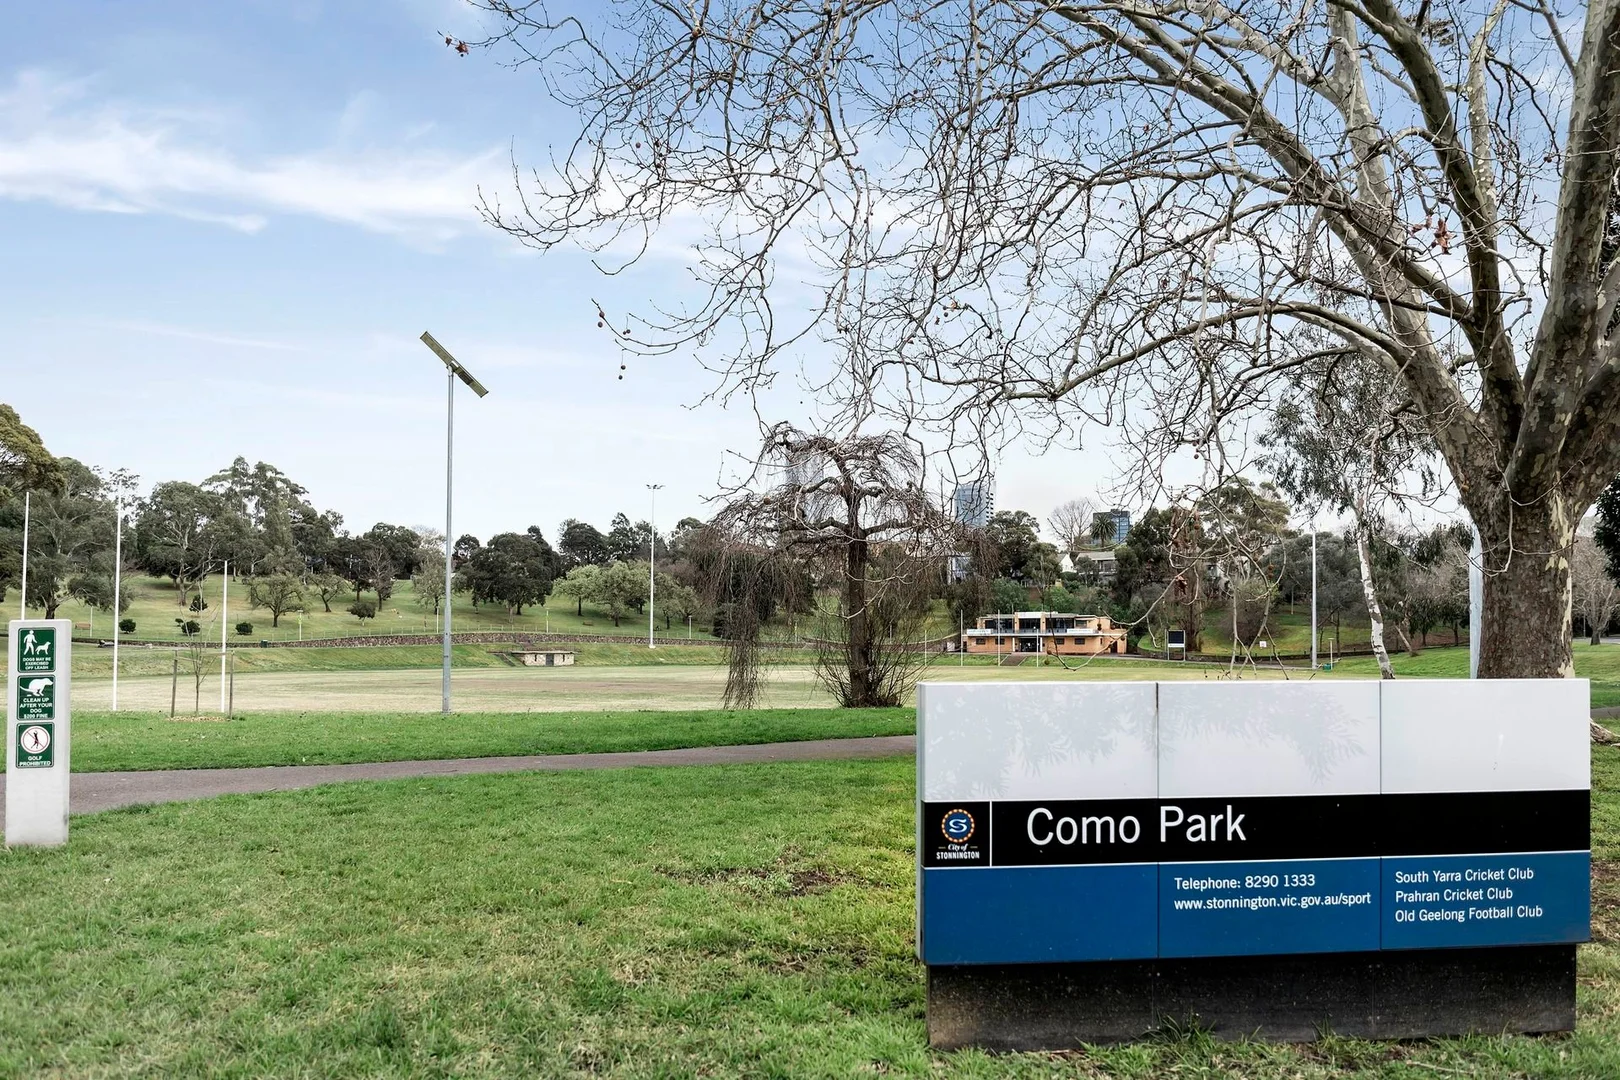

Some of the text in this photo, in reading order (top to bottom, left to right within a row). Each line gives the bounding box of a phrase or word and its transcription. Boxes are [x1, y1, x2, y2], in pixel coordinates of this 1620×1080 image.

[1027, 805, 1246, 845] Como Park
[1174, 874, 1316, 892] Telephone: 8290 1333
[1395, 868, 1534, 883] South Yarra Cricket Club
[1174, 892, 1371, 910] www.stonnington.vic.gov.au/sport
[1395, 888, 1513, 902] Prahran Cricket Club
[1395, 906, 1543, 922] Old Geelong Football Club
